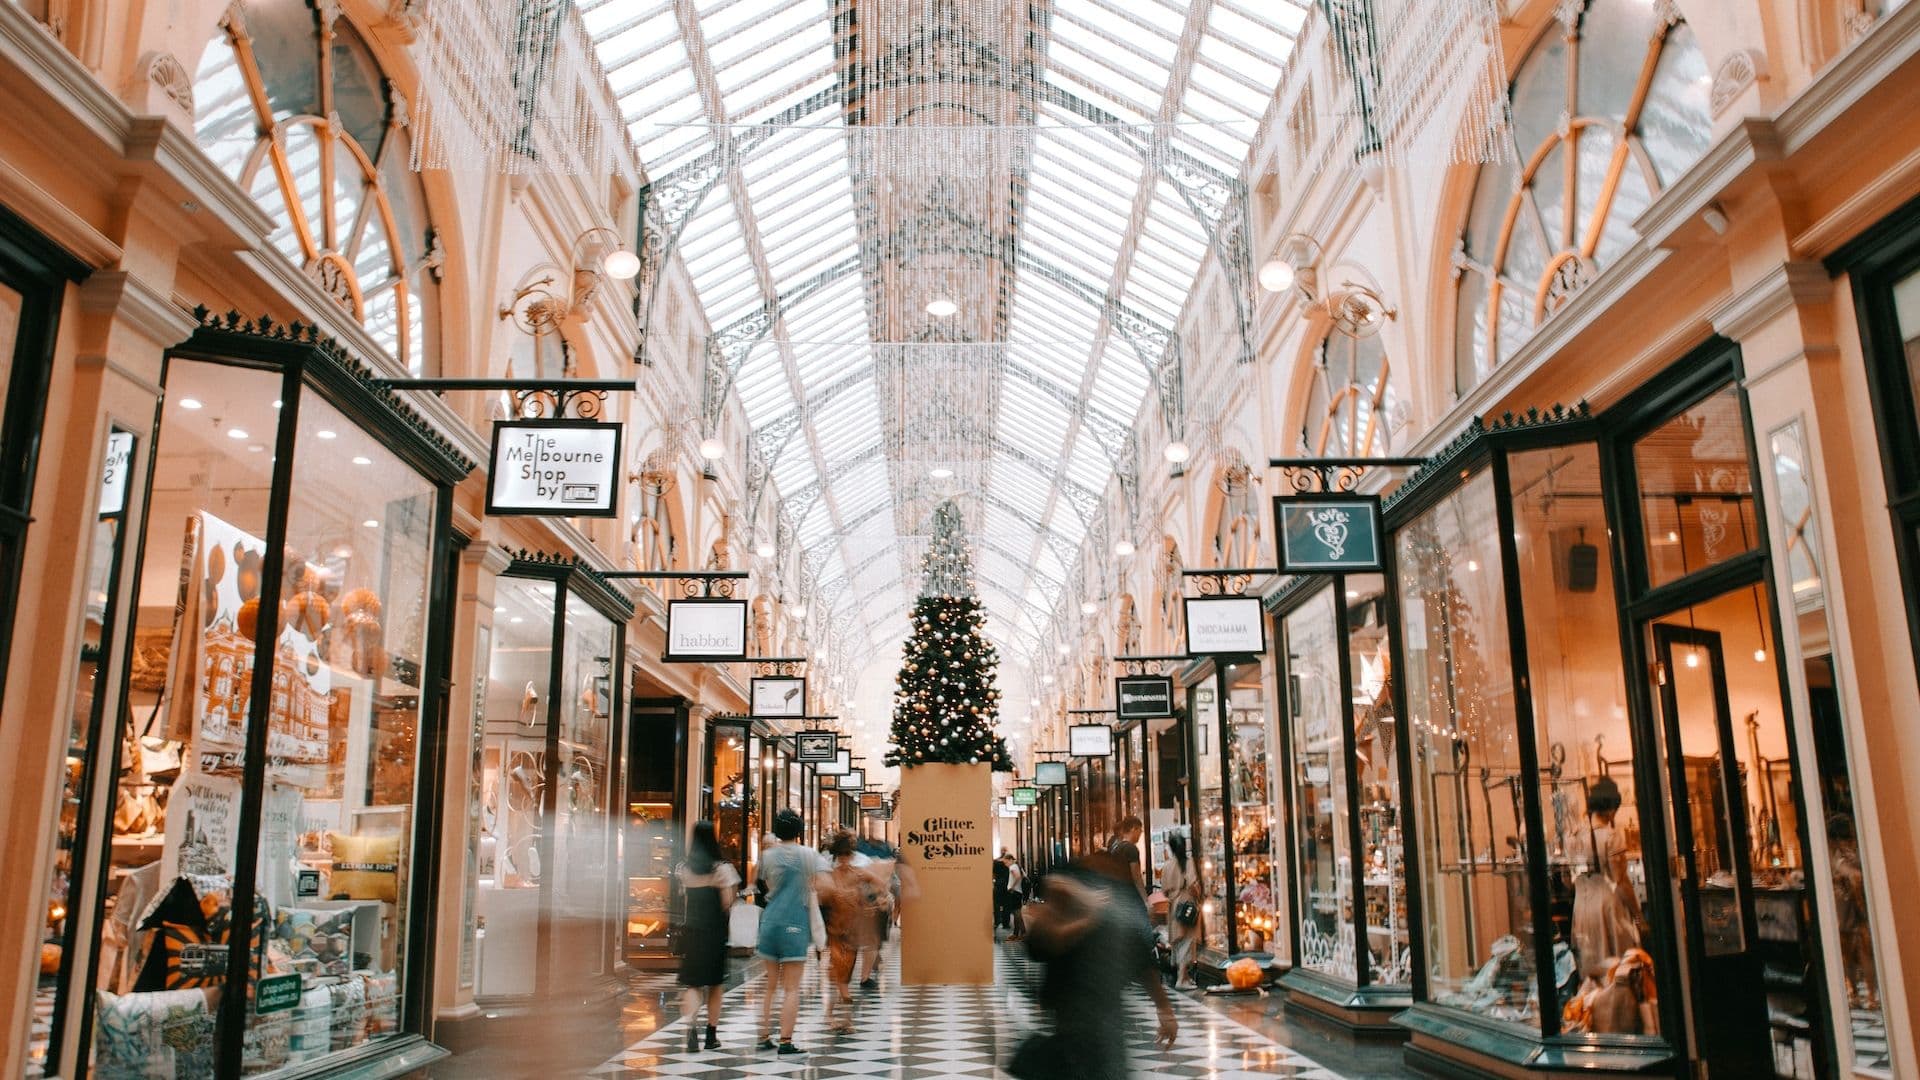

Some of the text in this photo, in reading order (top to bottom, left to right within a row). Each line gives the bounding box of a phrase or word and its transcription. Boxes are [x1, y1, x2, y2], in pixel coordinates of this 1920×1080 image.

[525, 433, 556, 449] The
[507, 446, 603, 463] Melbourne
[521, 464, 566, 484] Shop
[537, 486, 559, 500] by
[1197, 624, 1248, 634] CHOCAMAMA
[680, 633, 734, 647] habbot.
[924, 817, 975, 833] Glitter.
[907, 831, 963, 846] Sparkle
